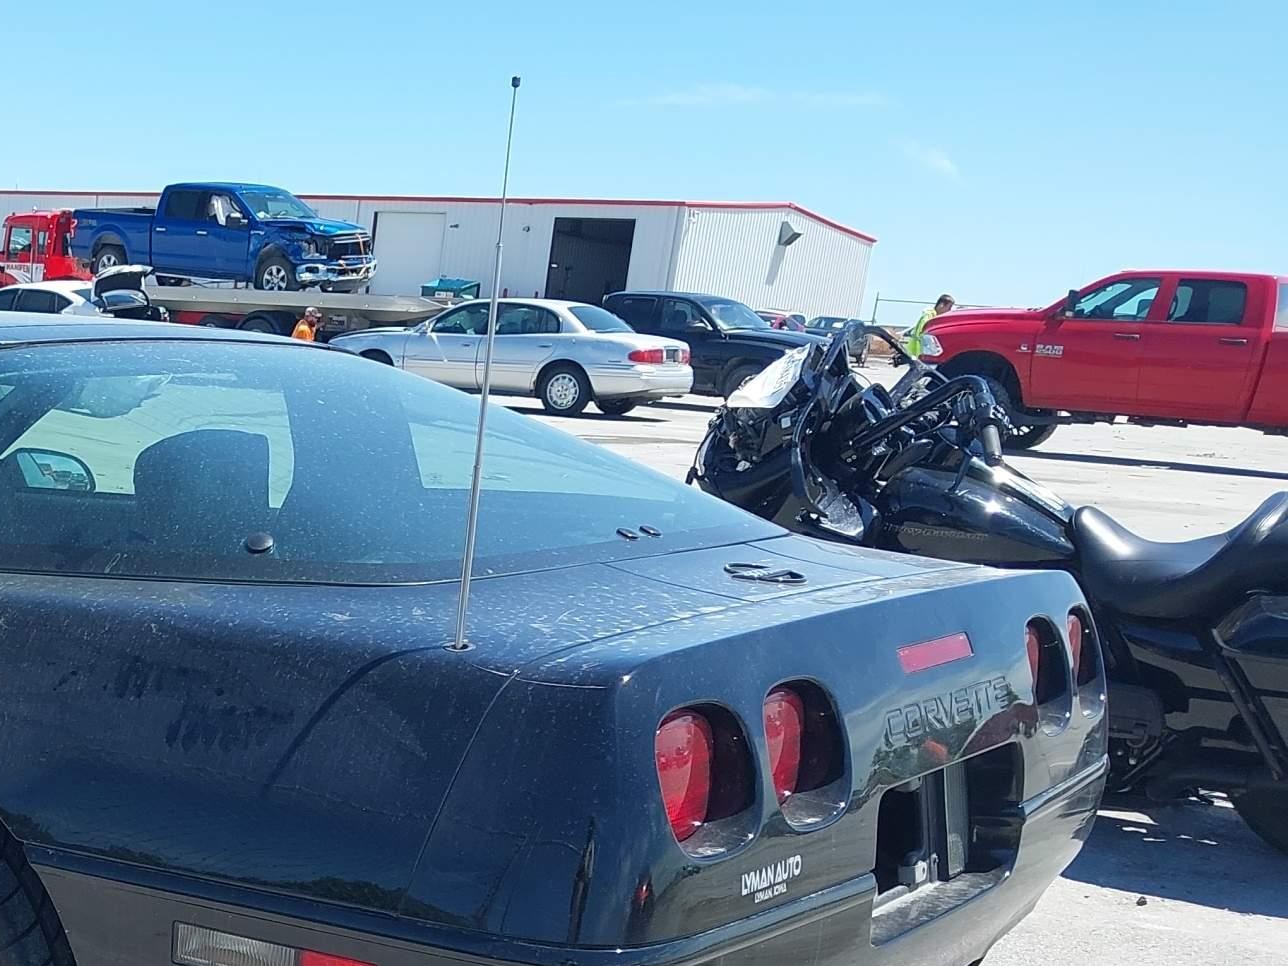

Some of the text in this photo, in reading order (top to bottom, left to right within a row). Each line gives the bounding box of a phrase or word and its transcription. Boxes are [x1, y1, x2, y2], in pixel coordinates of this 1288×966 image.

[885, 676, 1011, 746] CORVETTE
[742, 855, 801, 896] LYMAN AUTO
